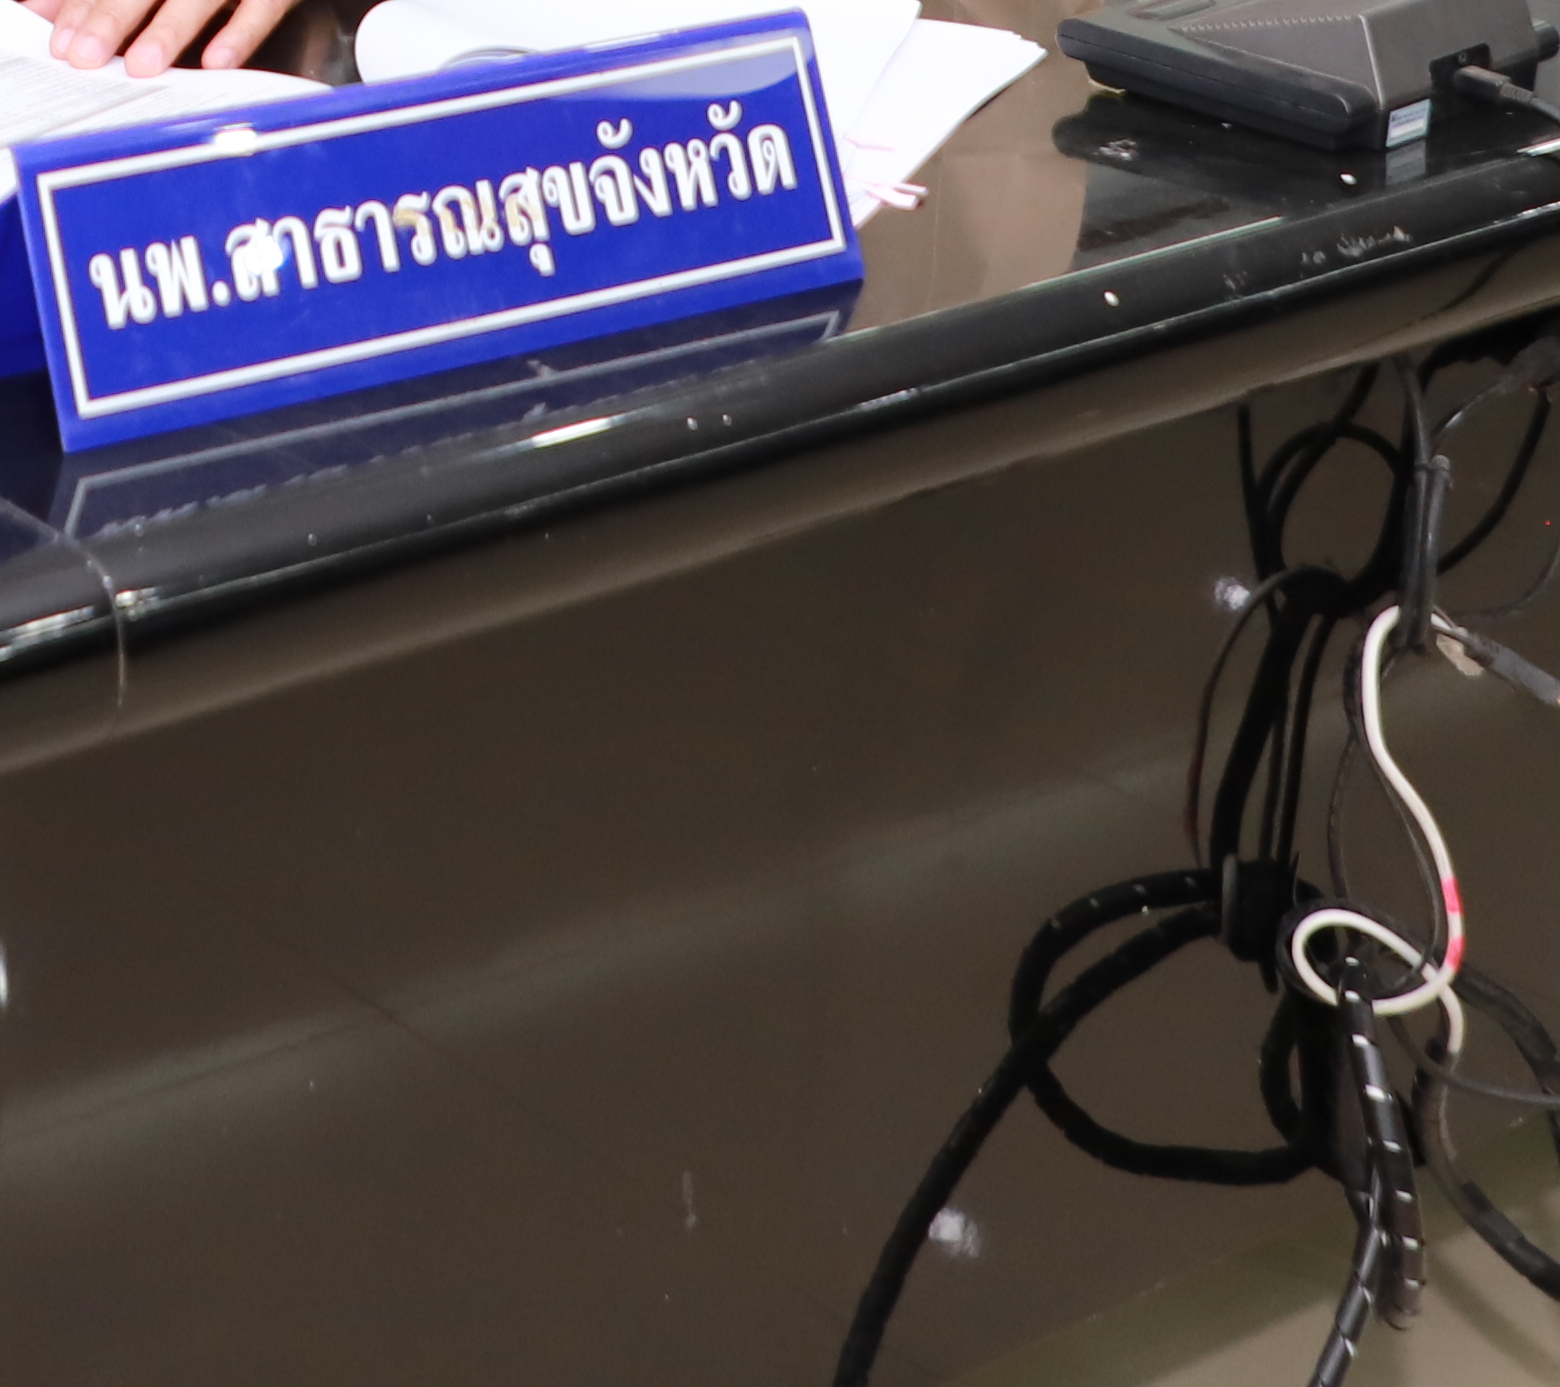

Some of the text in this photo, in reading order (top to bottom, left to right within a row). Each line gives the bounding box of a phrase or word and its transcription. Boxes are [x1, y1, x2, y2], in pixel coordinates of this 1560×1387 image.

[89, 100, 799, 330] นพ.สาธารณสุขจังหวัด
